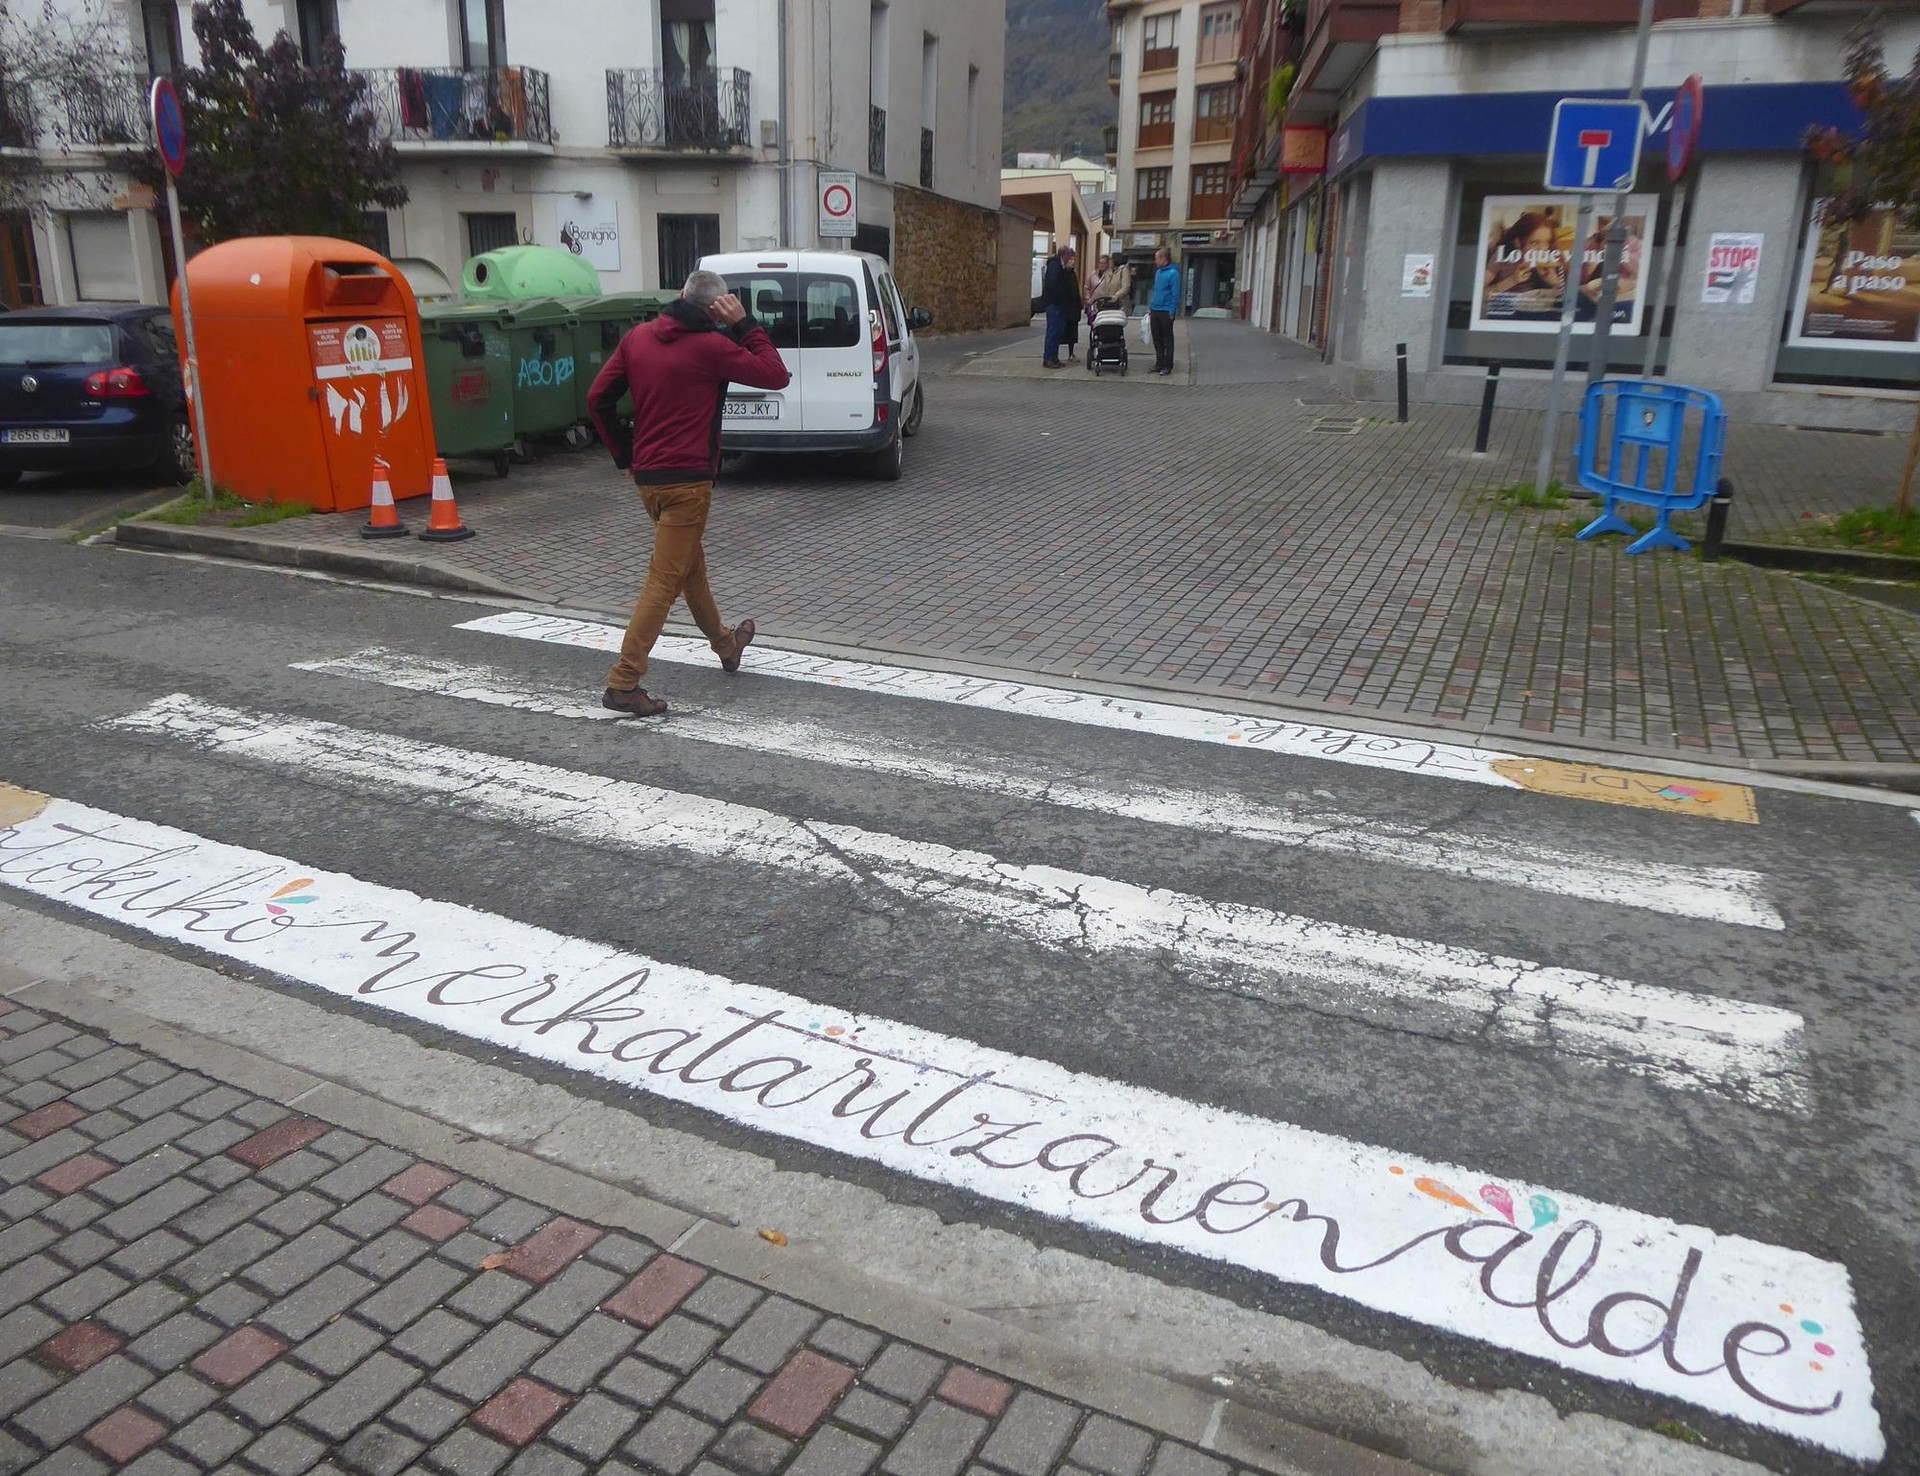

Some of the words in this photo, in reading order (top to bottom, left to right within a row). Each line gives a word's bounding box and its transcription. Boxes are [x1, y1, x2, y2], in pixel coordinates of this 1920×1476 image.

[1495, 244, 1522, 263] Lo
[1524, 248, 1561, 268] que
[1710, 246, 1758, 268] STOP!
[1843, 250, 1902, 270] Paso
[1830, 274, 1848, 289] a
[1847, 275, 1906, 297] paso
[750, 403, 771, 415] JKY
[10, 429, 40, 441] 2656
[1560, 768, 1672, 794] ADE
[0, 821, 296, 943] tokiko
[358, 919, 1365, 1274] merkataritzaren
[1443, 1219, 1844, 1417] alde
